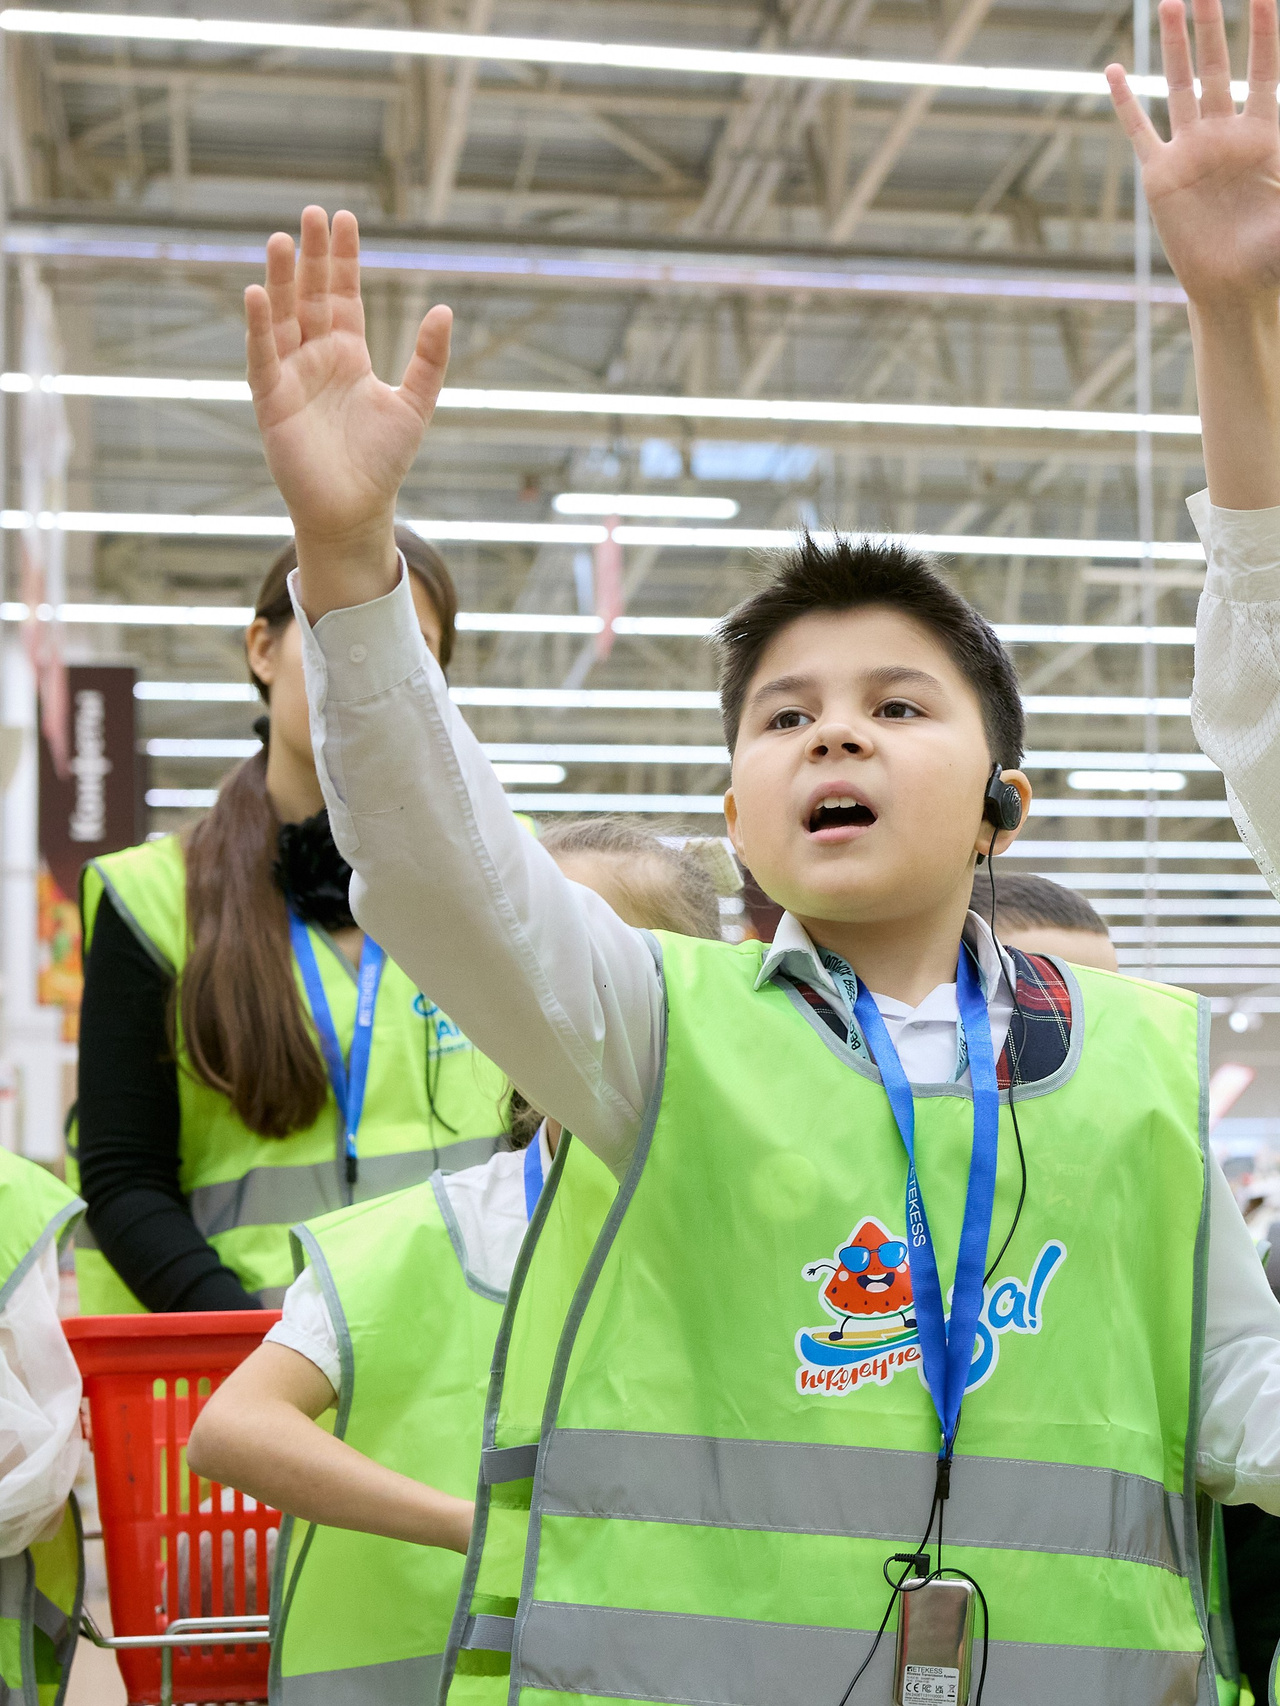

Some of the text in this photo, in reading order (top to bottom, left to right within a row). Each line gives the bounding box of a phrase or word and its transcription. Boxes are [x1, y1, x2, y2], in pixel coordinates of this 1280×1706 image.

[908, 1166, 926, 1248] ETEKESS
[801, 1347, 921, 1391] поколение
[907, 1666, 943, 1675] RETEKESS
